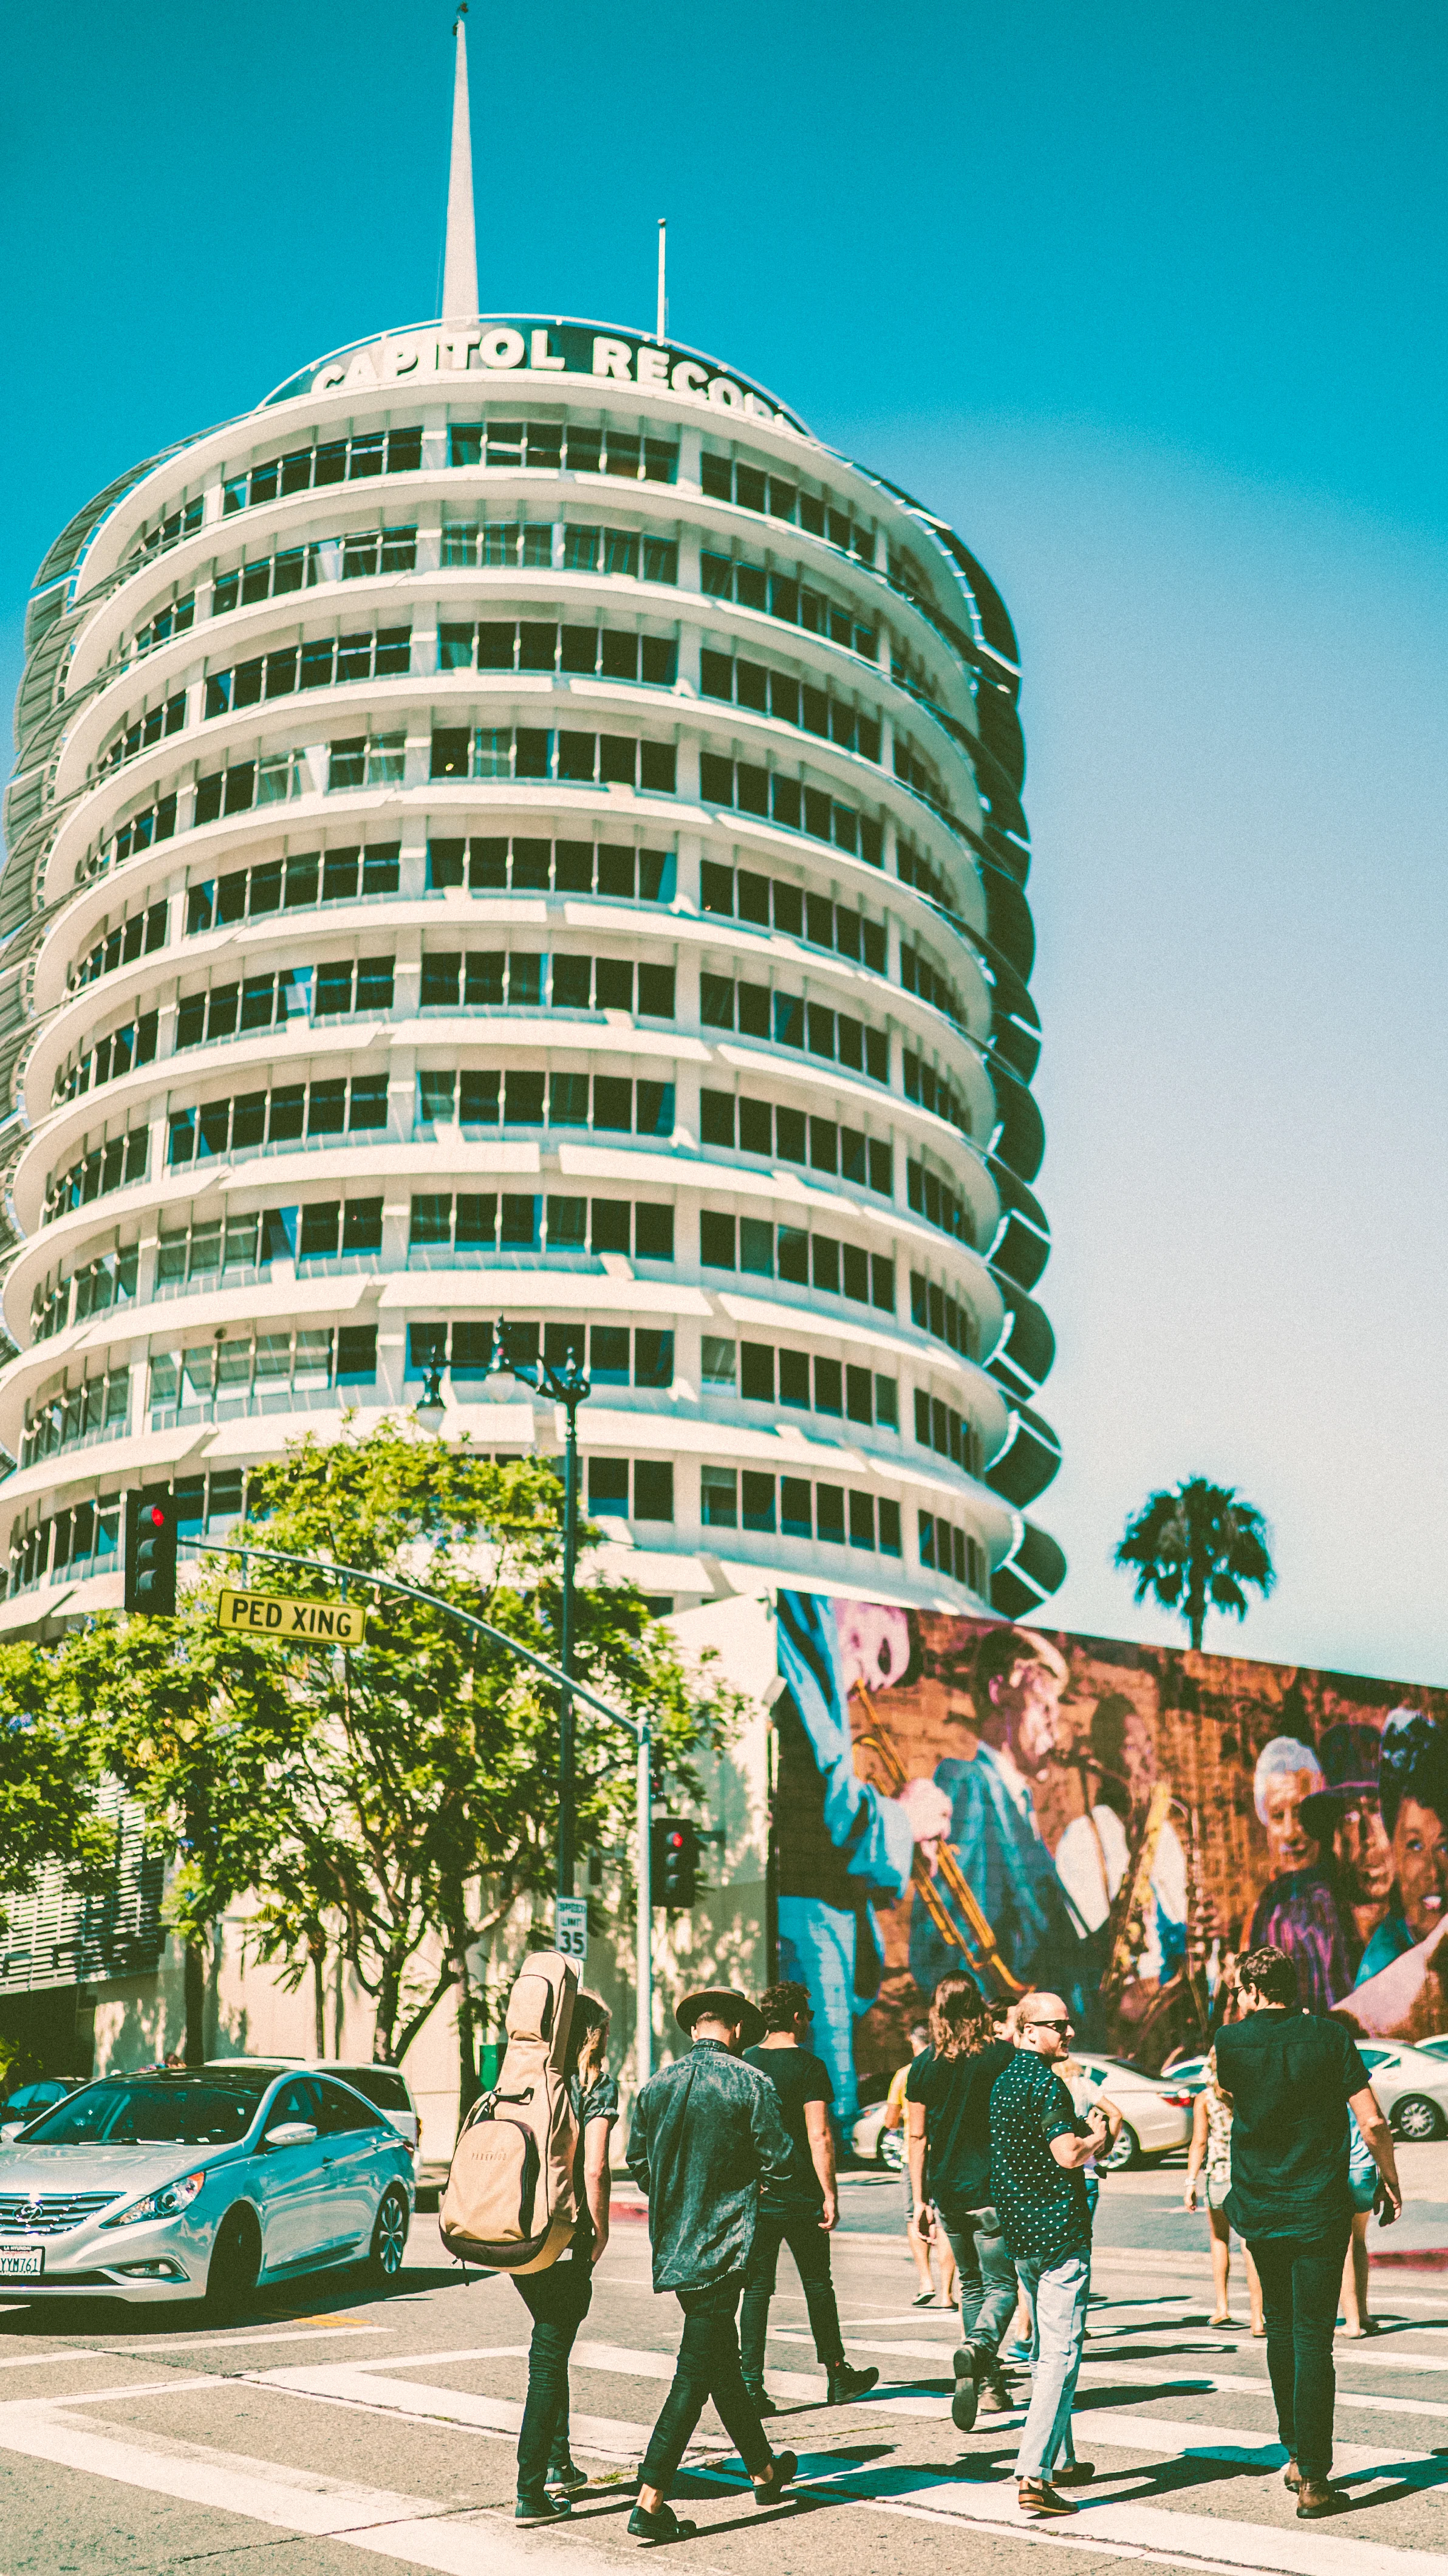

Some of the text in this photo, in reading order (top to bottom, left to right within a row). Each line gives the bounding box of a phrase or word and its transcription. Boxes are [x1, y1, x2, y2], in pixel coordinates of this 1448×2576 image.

[310, 327, 565, 395] CAPITOL
[231, 1598, 351, 1637] PED XING
[558, 1902, 586, 1913] SPEED
[561, 1917, 581, 1927] LIMIT
[559, 1930, 584, 1954] 35
